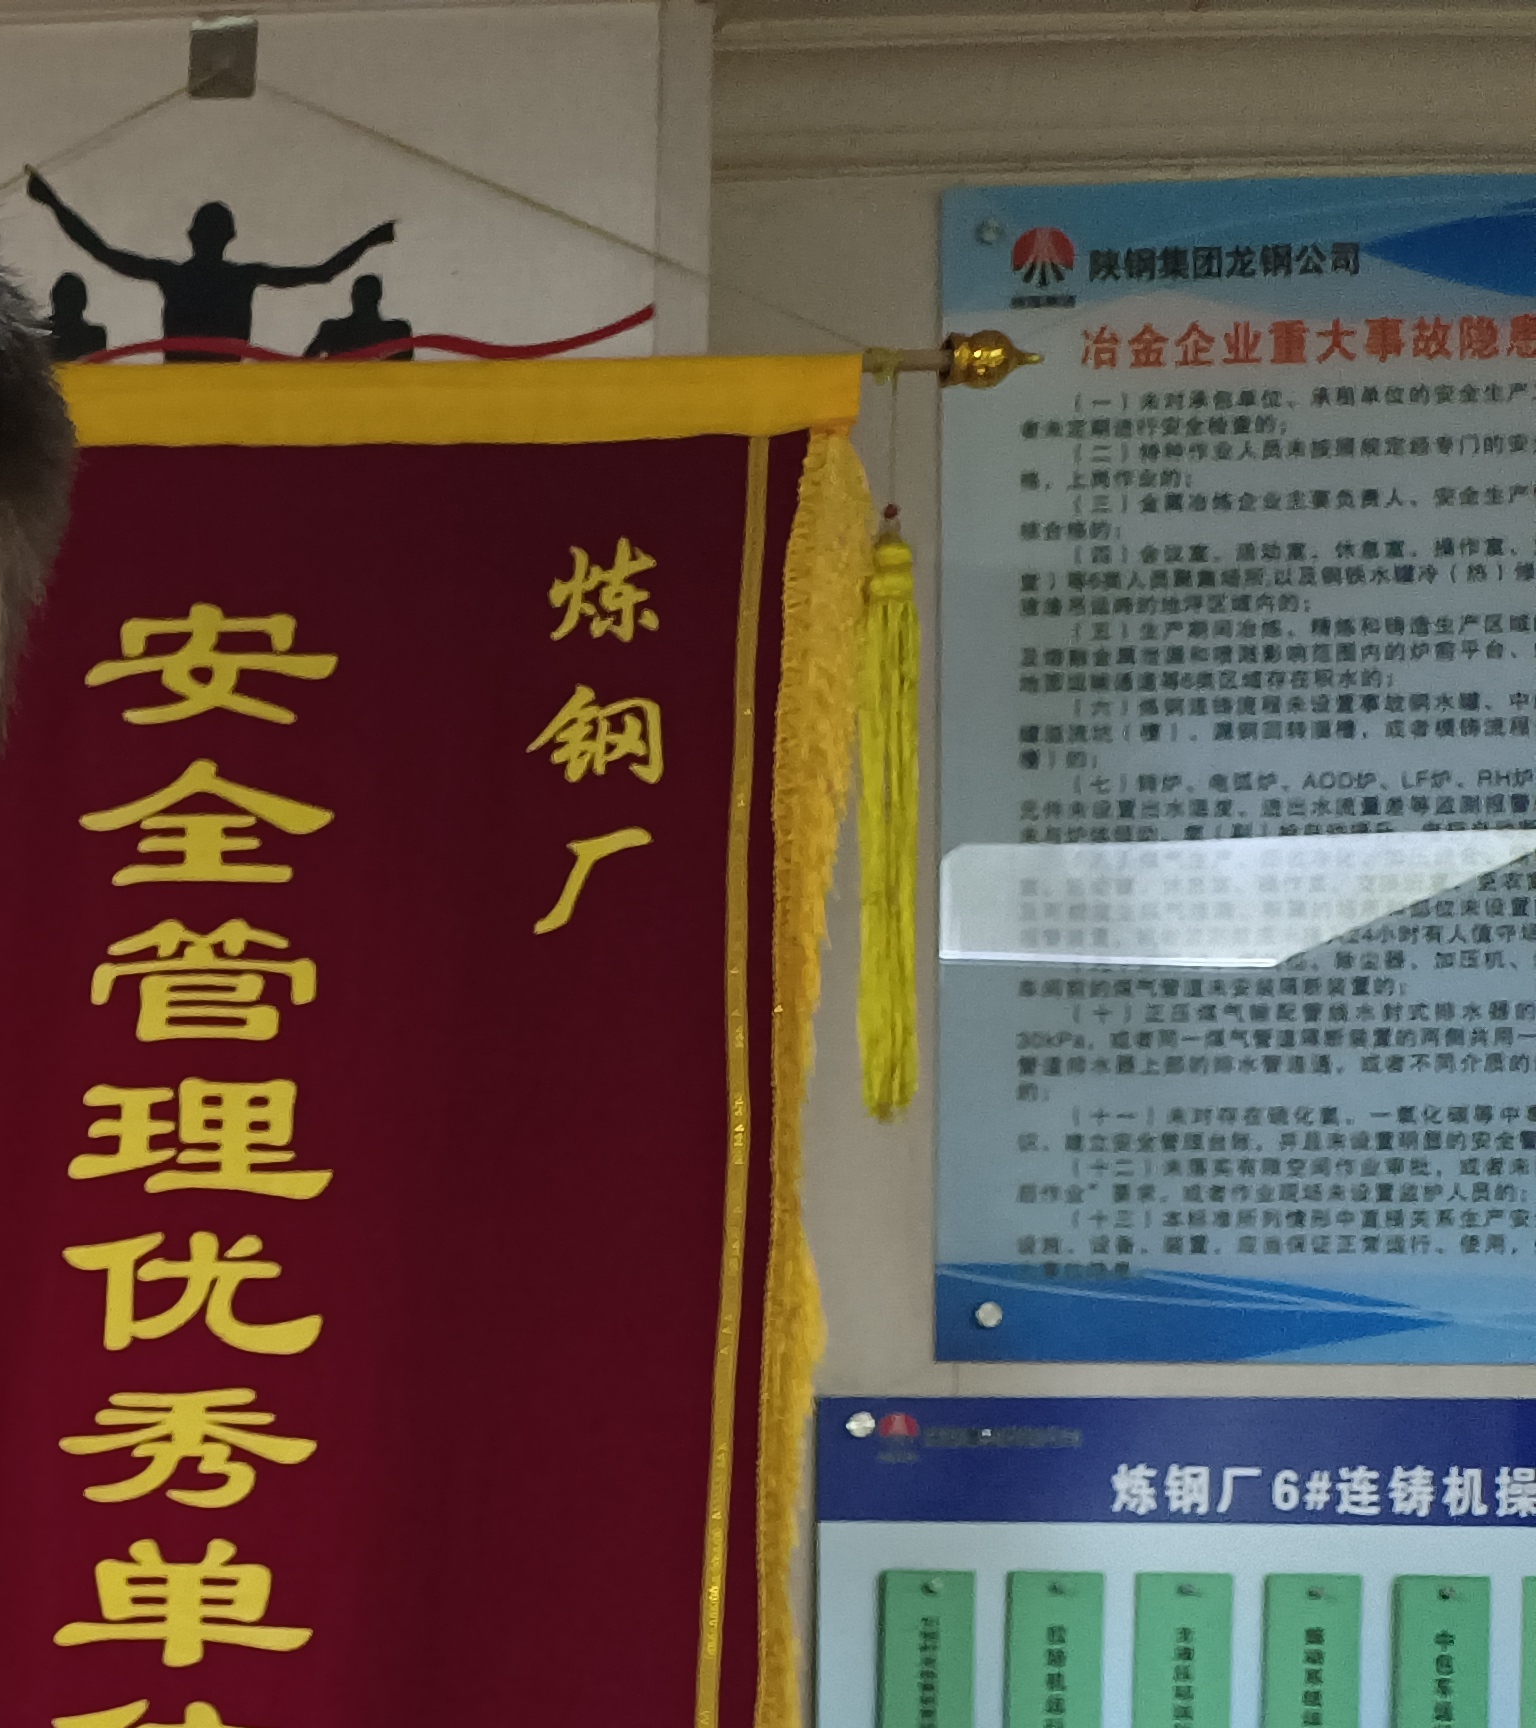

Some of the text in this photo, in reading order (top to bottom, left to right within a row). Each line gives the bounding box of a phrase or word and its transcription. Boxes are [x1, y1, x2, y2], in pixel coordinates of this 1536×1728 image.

[1089, 241, 1360, 281] 陕钢集团龙钢公司
[527, 536, 663, 934] 炼钢厂
